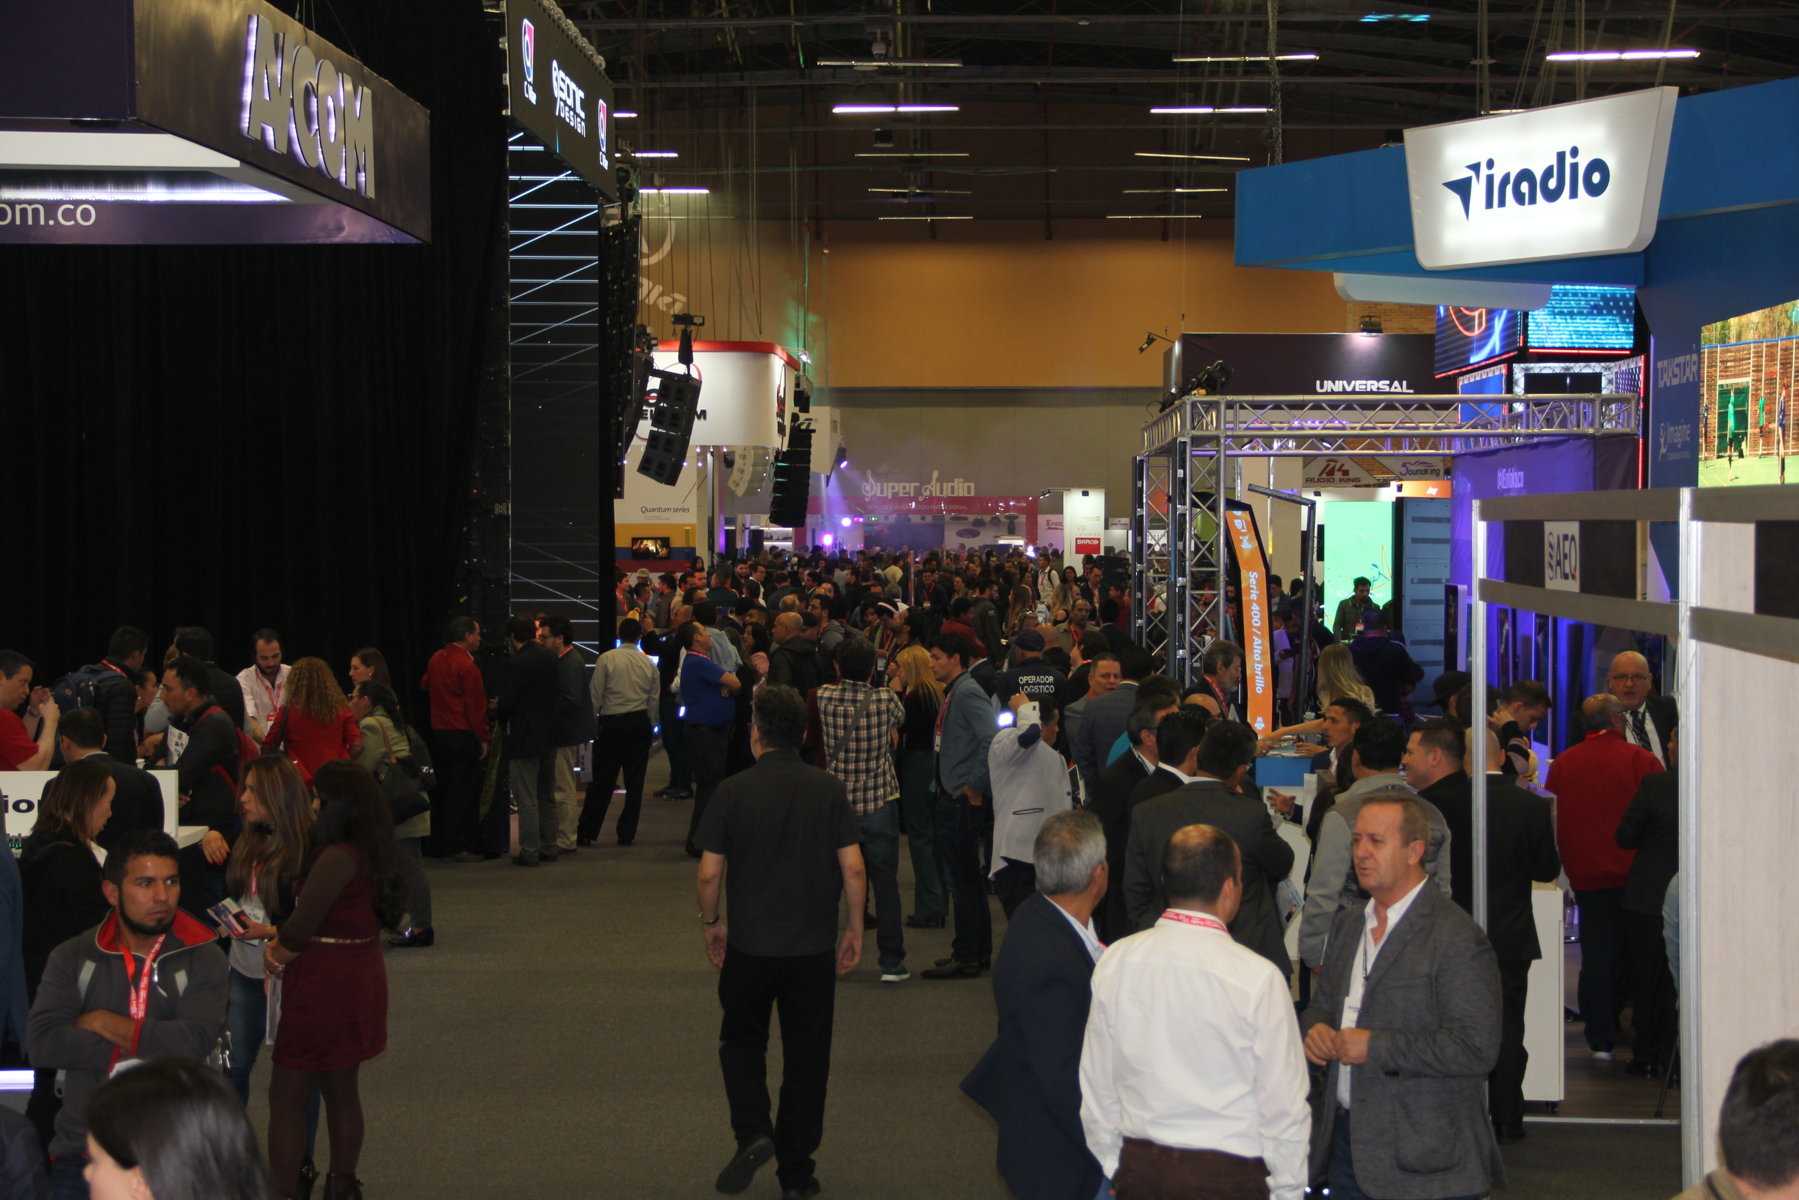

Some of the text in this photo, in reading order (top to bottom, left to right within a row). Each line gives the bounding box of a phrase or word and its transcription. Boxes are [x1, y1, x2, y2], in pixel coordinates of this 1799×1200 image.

[1485, 145, 1610, 210] iradio
[0, 203, 96, 226] om.co
[1657, 353, 1698, 388] TAKSTAR
[1315, 379, 1414, 394] UNIVERSAL
[861, 469, 975, 502] Super Audio
[640, 504, 690, 514] Quantum series
[1555, 533, 1577, 582] AEQ
[1248, 571, 1259, 600] Serie
[1250, 603, 1261, 627] 400
[1252, 636, 1263, 662] Alto
[1018, 675, 1054, 685] OPERADOR
[1253, 663, 1265, 694] brillo
